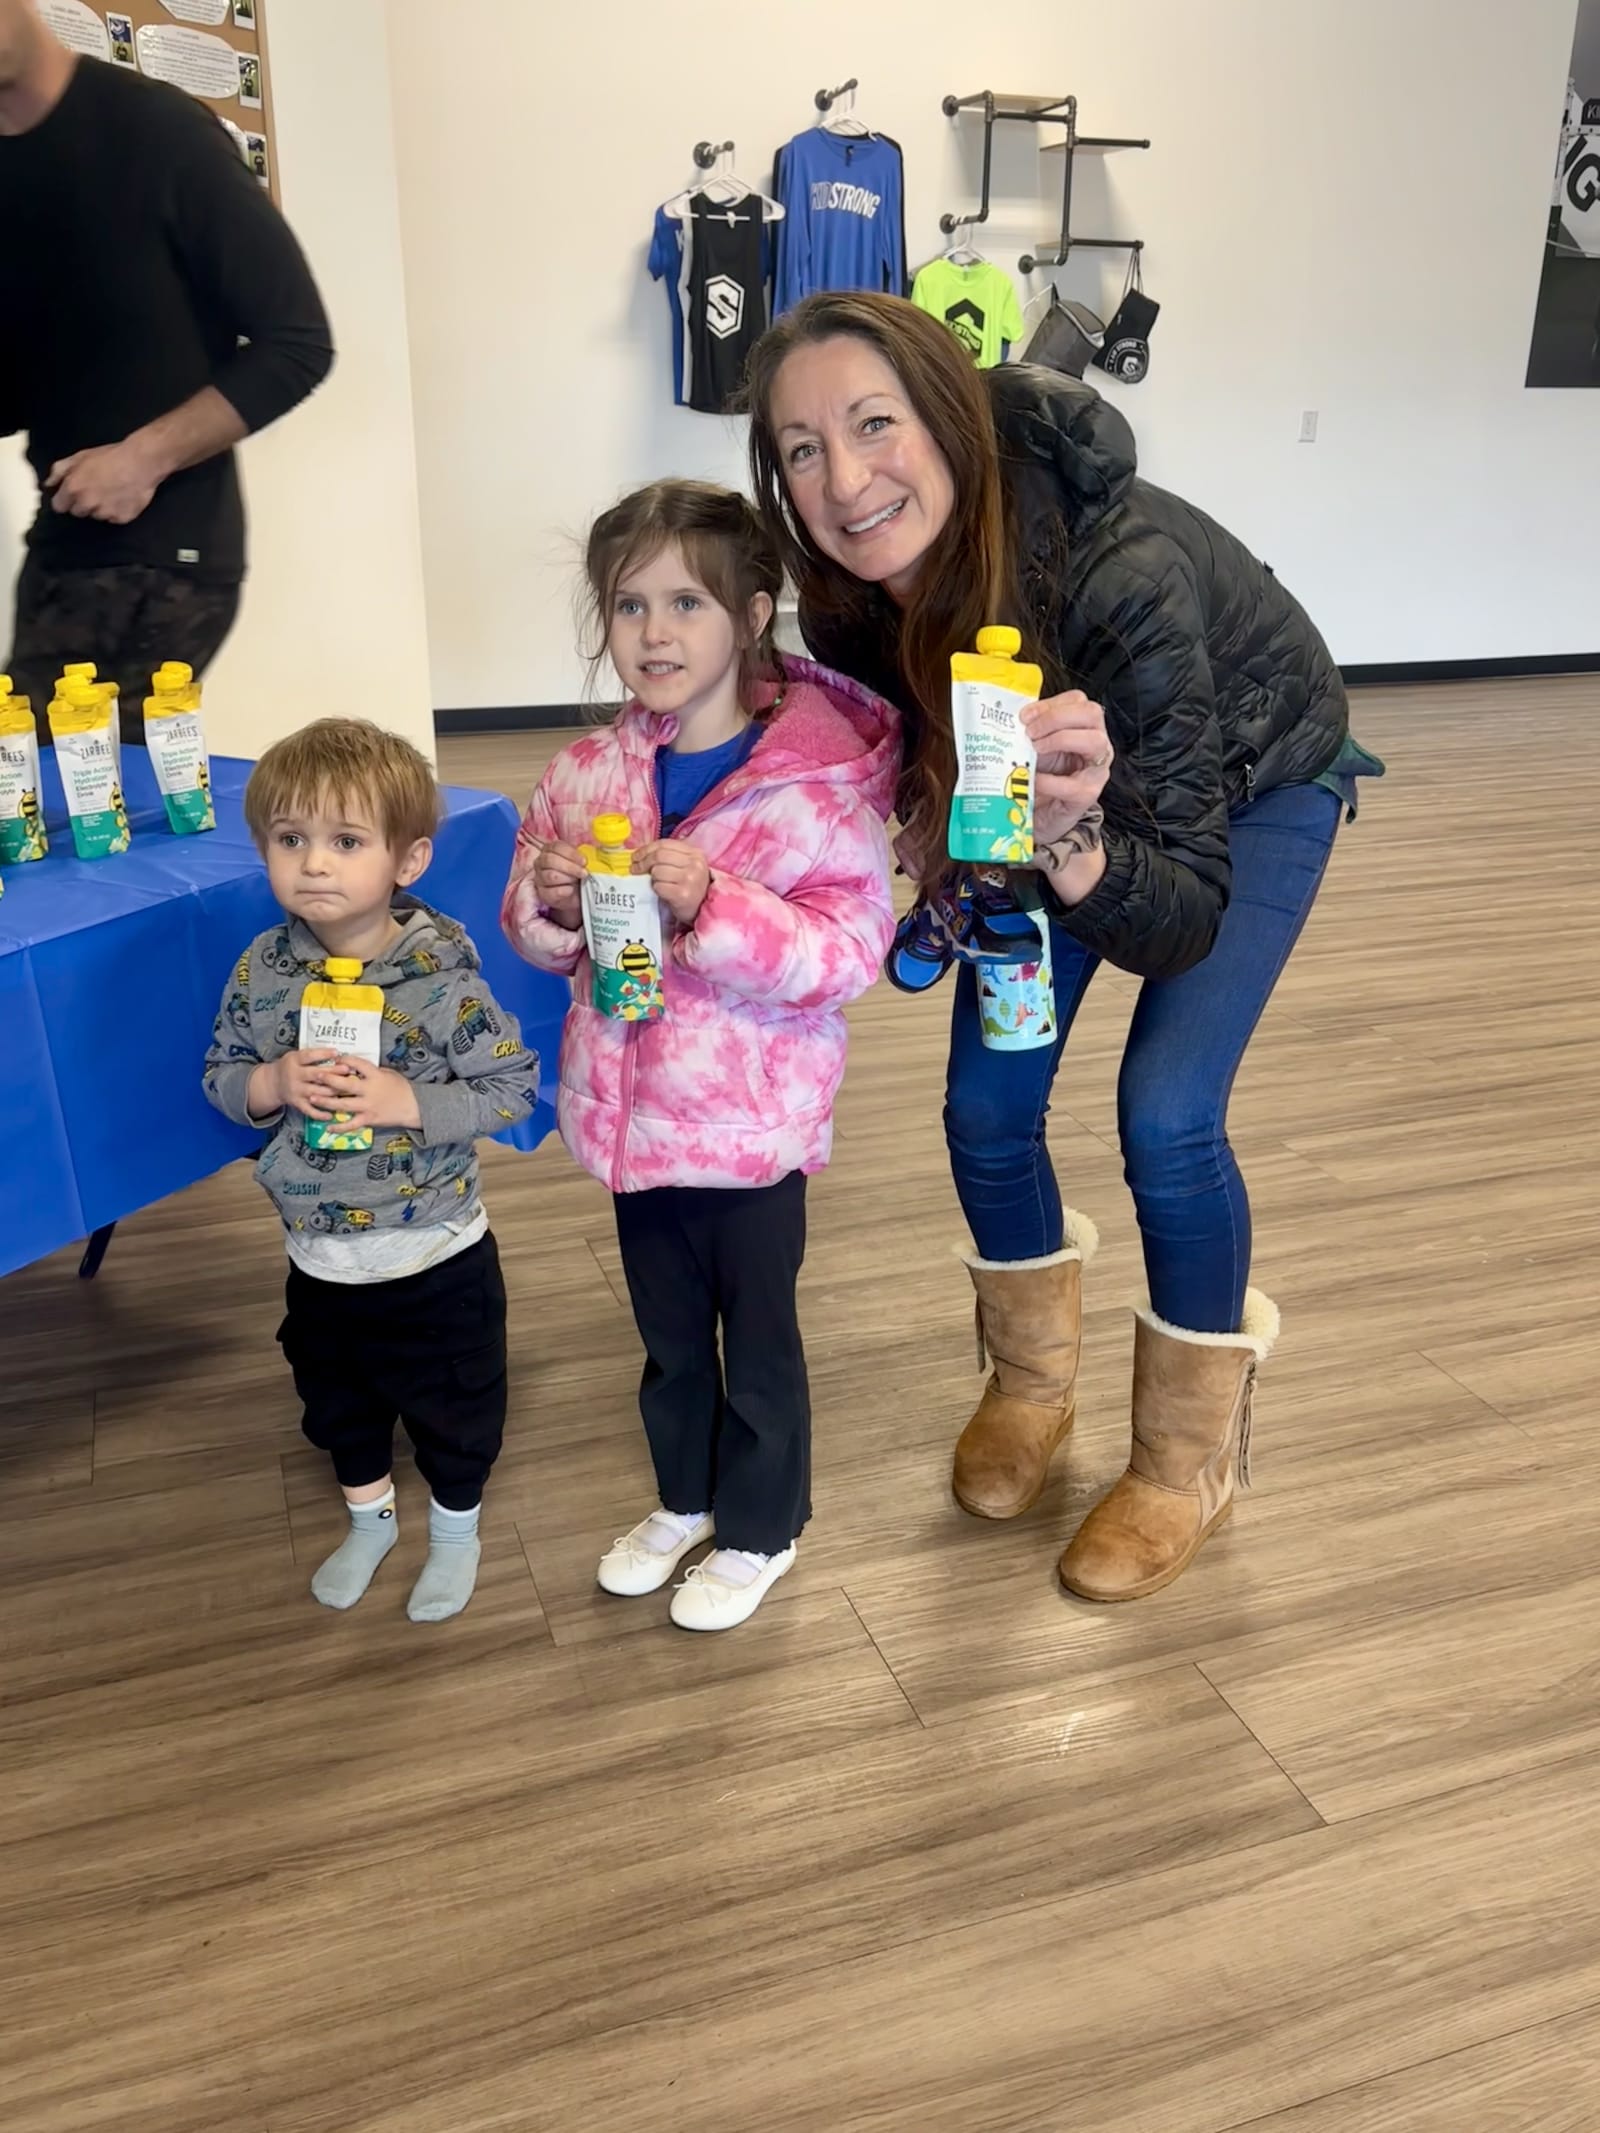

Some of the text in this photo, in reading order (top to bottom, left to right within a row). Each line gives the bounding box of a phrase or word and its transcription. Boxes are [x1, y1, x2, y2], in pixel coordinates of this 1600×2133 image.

[811, 181, 881, 219] KIDSTRONG
[965, 733, 991, 743] Triple
[80, 744, 112, 760] ZARBEE
[965, 763, 987, 772] Drink
[595, 891, 636, 909] ZARBEES
[605, 917, 631, 927] Action
[315, 1024, 358, 1041] ZARBEES
